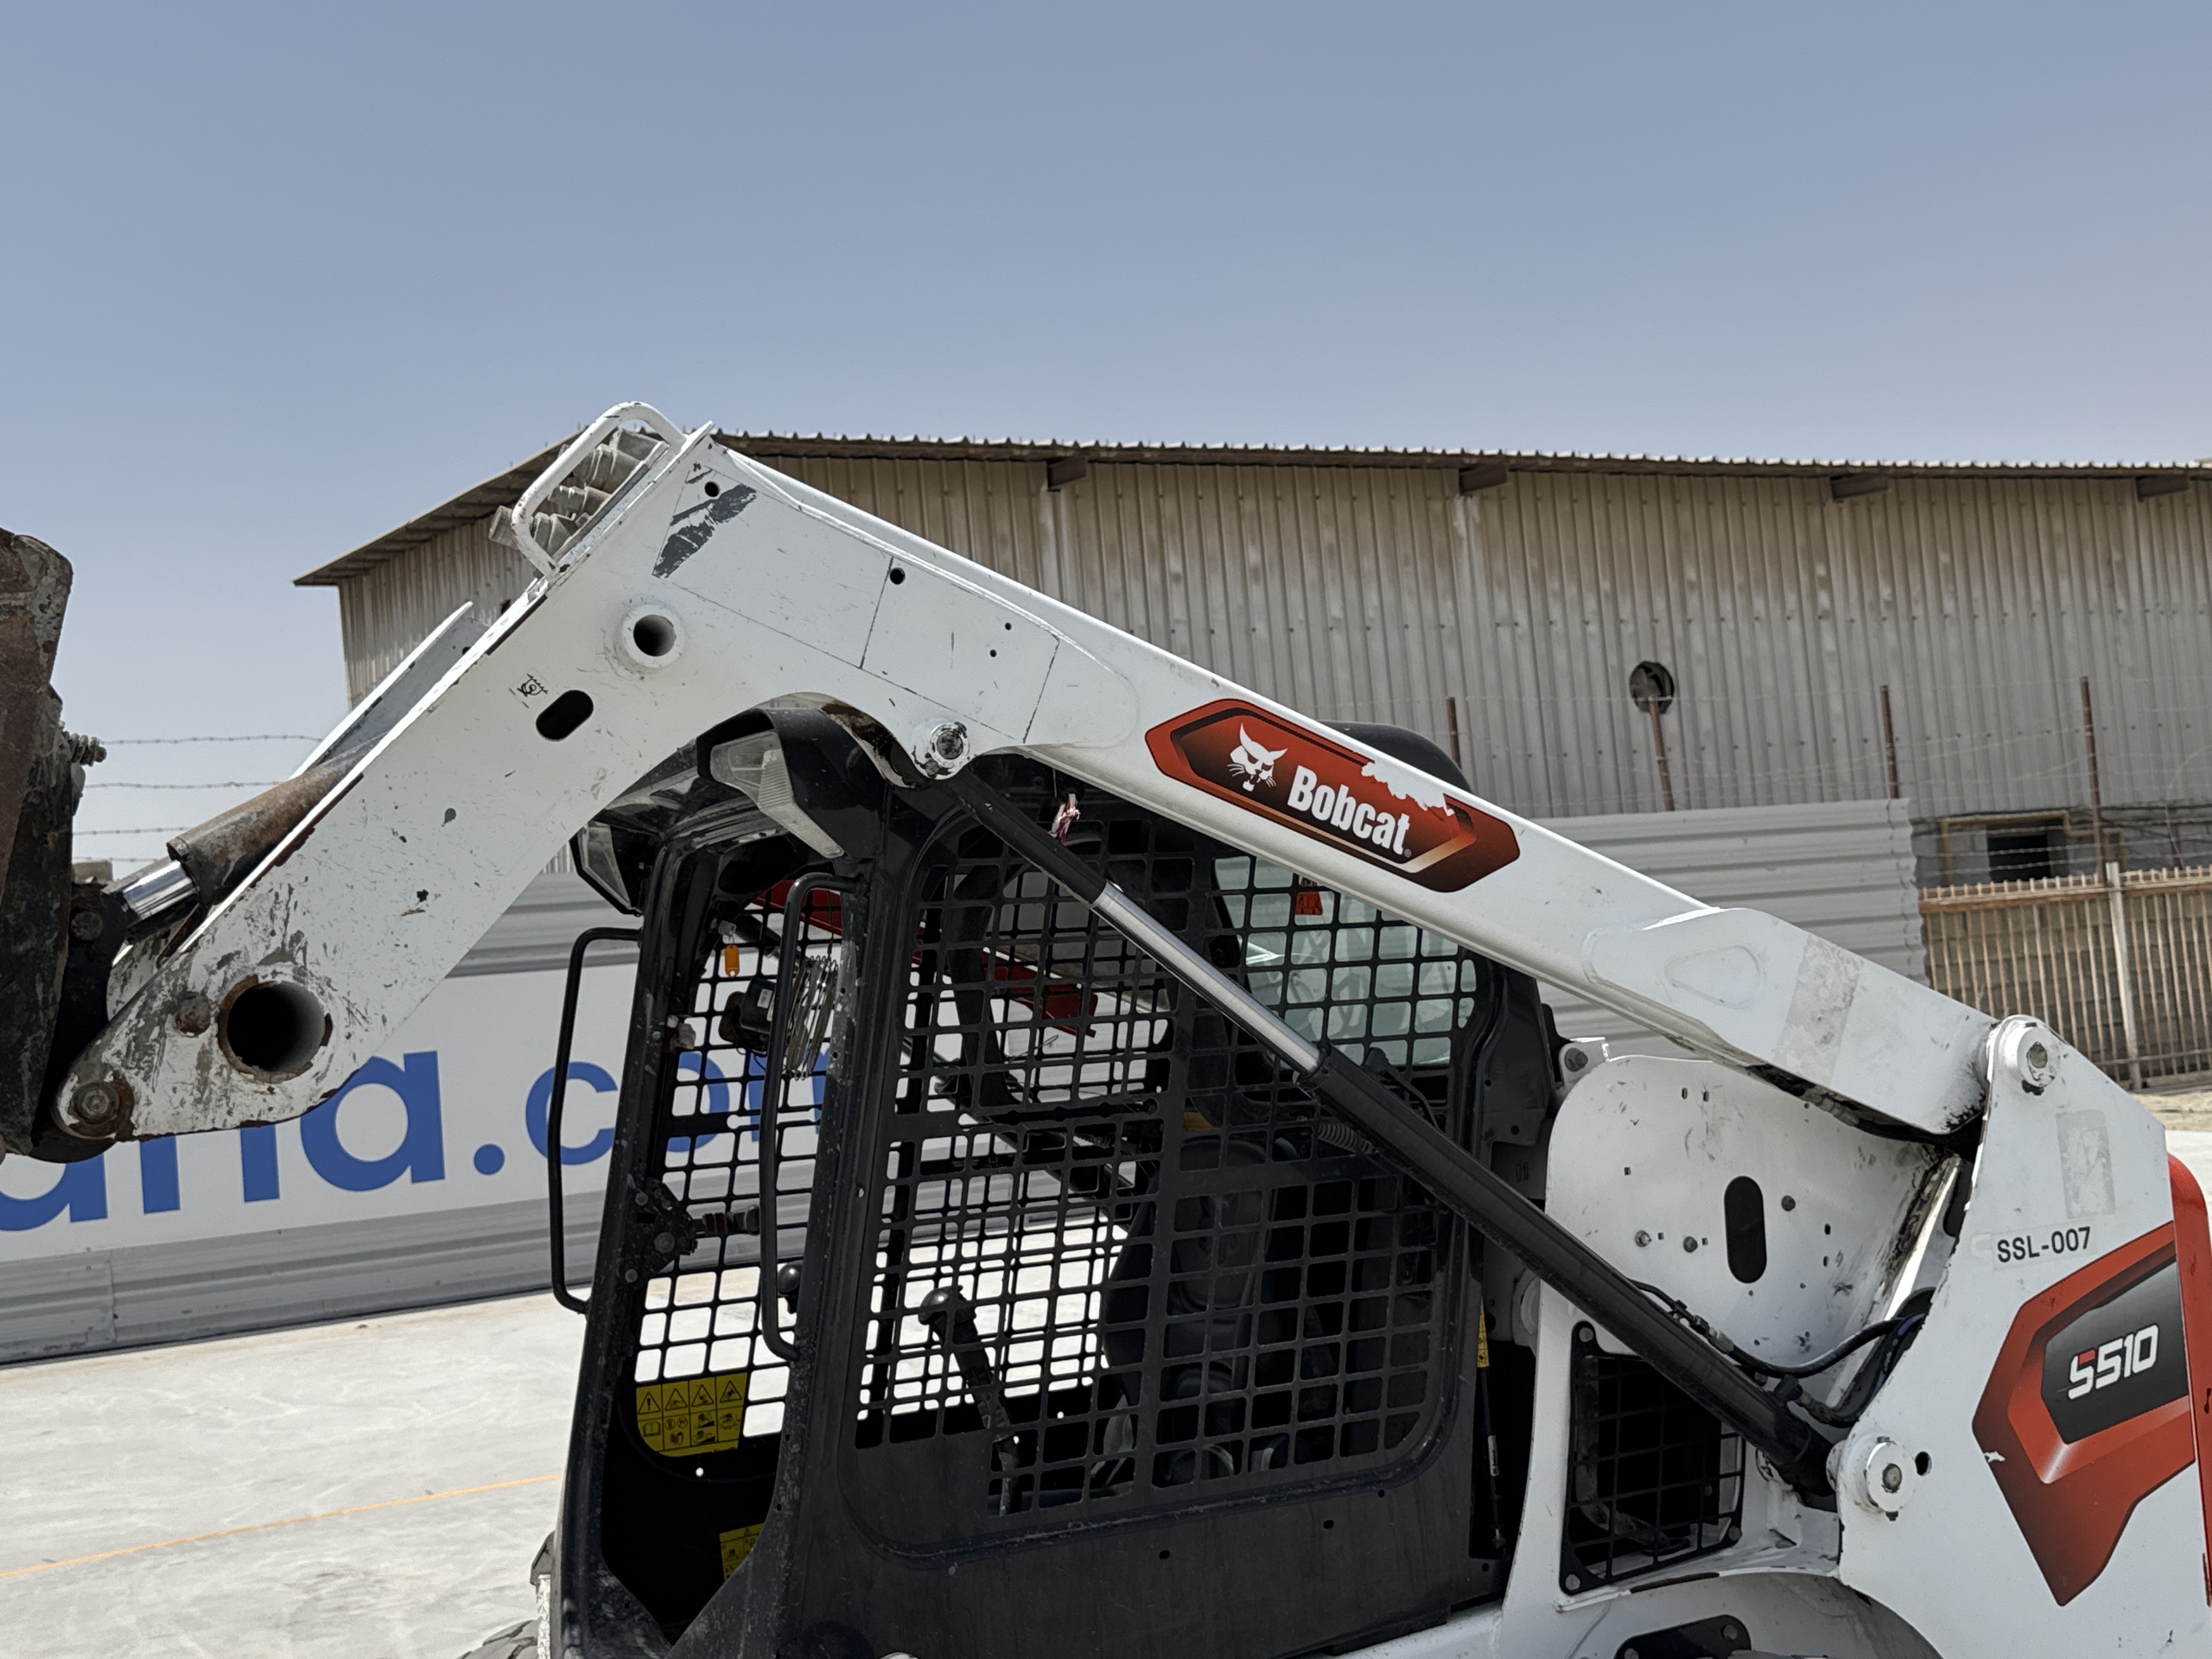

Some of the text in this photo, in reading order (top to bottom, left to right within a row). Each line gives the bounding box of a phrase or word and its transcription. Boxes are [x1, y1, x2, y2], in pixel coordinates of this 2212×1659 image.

[1287, 765, 1410, 855] Bobcat
[1997, 1226, 2091, 1262] SSL-007
[2068, 1324, 2159, 1400] S510
